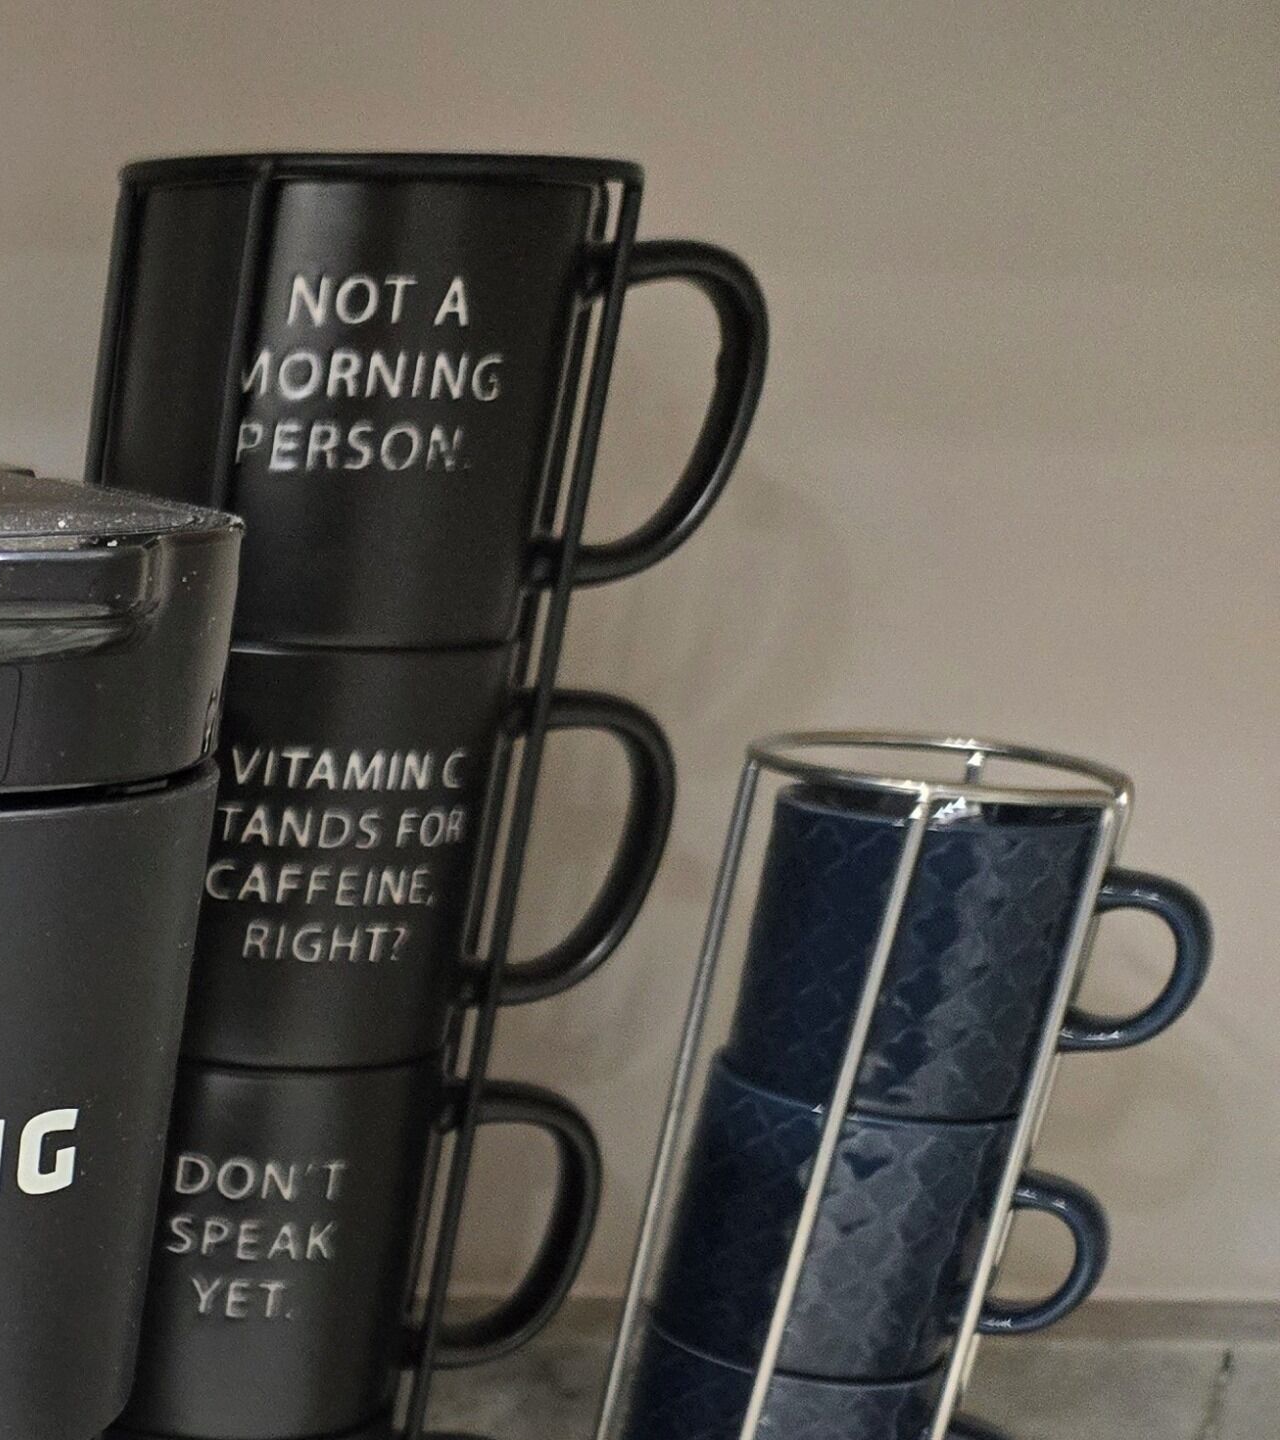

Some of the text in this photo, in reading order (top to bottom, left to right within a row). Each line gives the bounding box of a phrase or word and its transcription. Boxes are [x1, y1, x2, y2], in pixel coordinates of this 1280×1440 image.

[285, 275, 470, 327] NOT A
[230, 747, 466, 792] VITAMIN C
[218, 805, 465, 850] TANDS FOR
[241, 921, 412, 963] RIGHT?
[174, 1153, 345, 1201] DON'T
[167, 1214, 334, 1262] SPEAK
[191, 1275, 294, 1321] YET.
